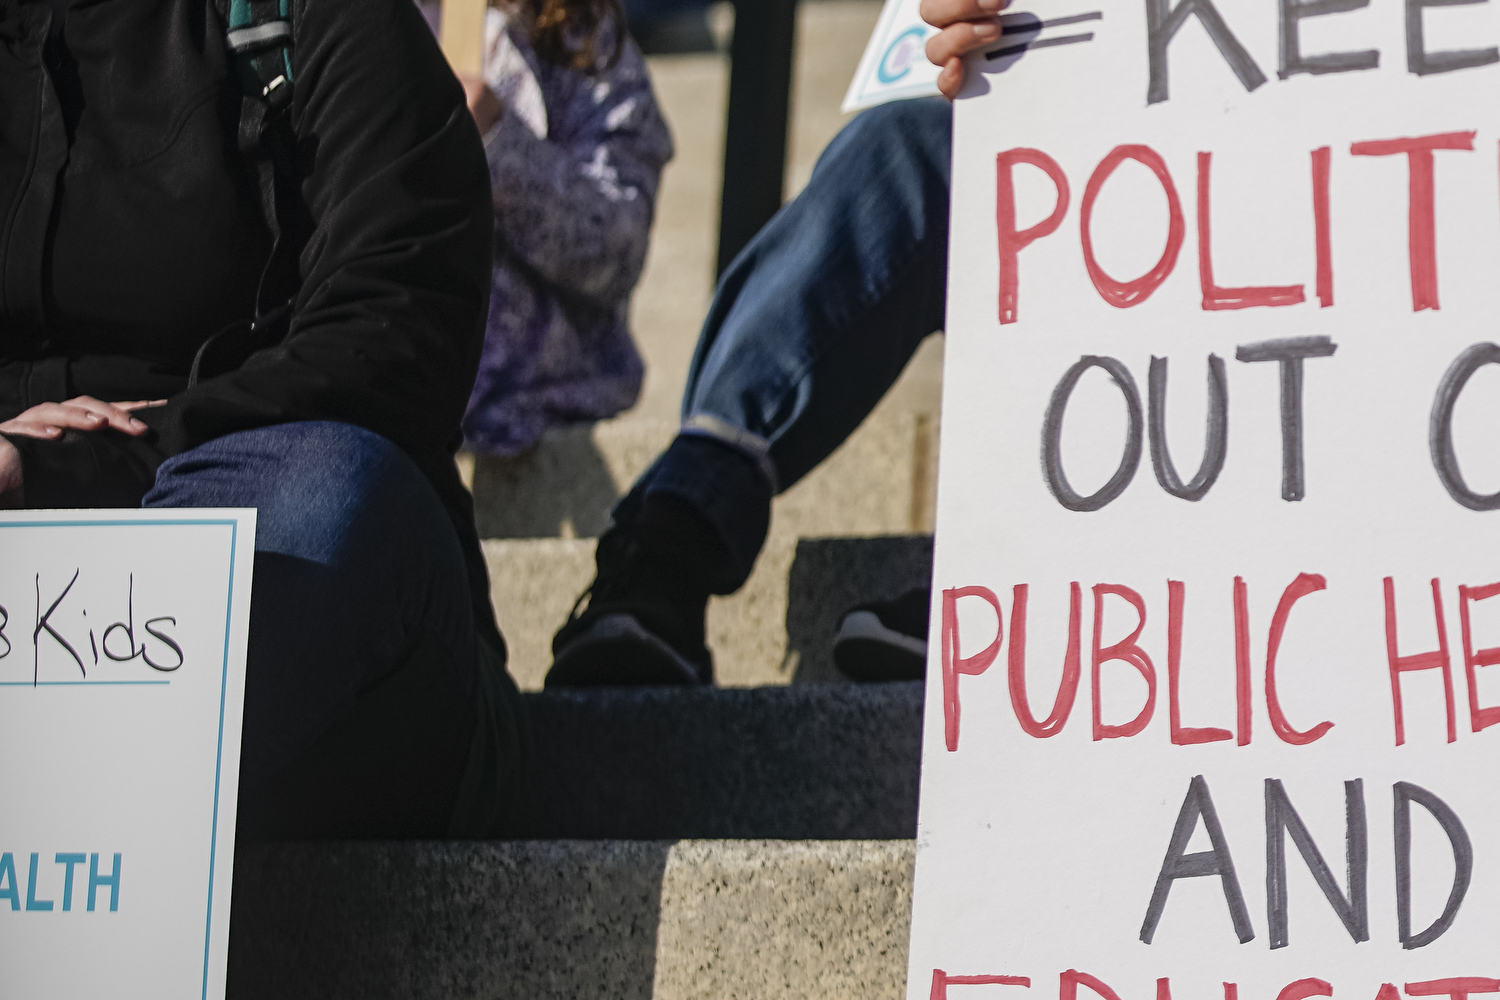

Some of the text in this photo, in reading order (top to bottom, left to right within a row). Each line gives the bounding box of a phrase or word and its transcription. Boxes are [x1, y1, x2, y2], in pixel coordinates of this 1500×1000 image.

[1041, 335, 1338, 513] OUT
[33, 567, 185, 688] Kids
[940, 573, 1335, 753] PUBLIC
[1139, 775, 1474, 950] AND
